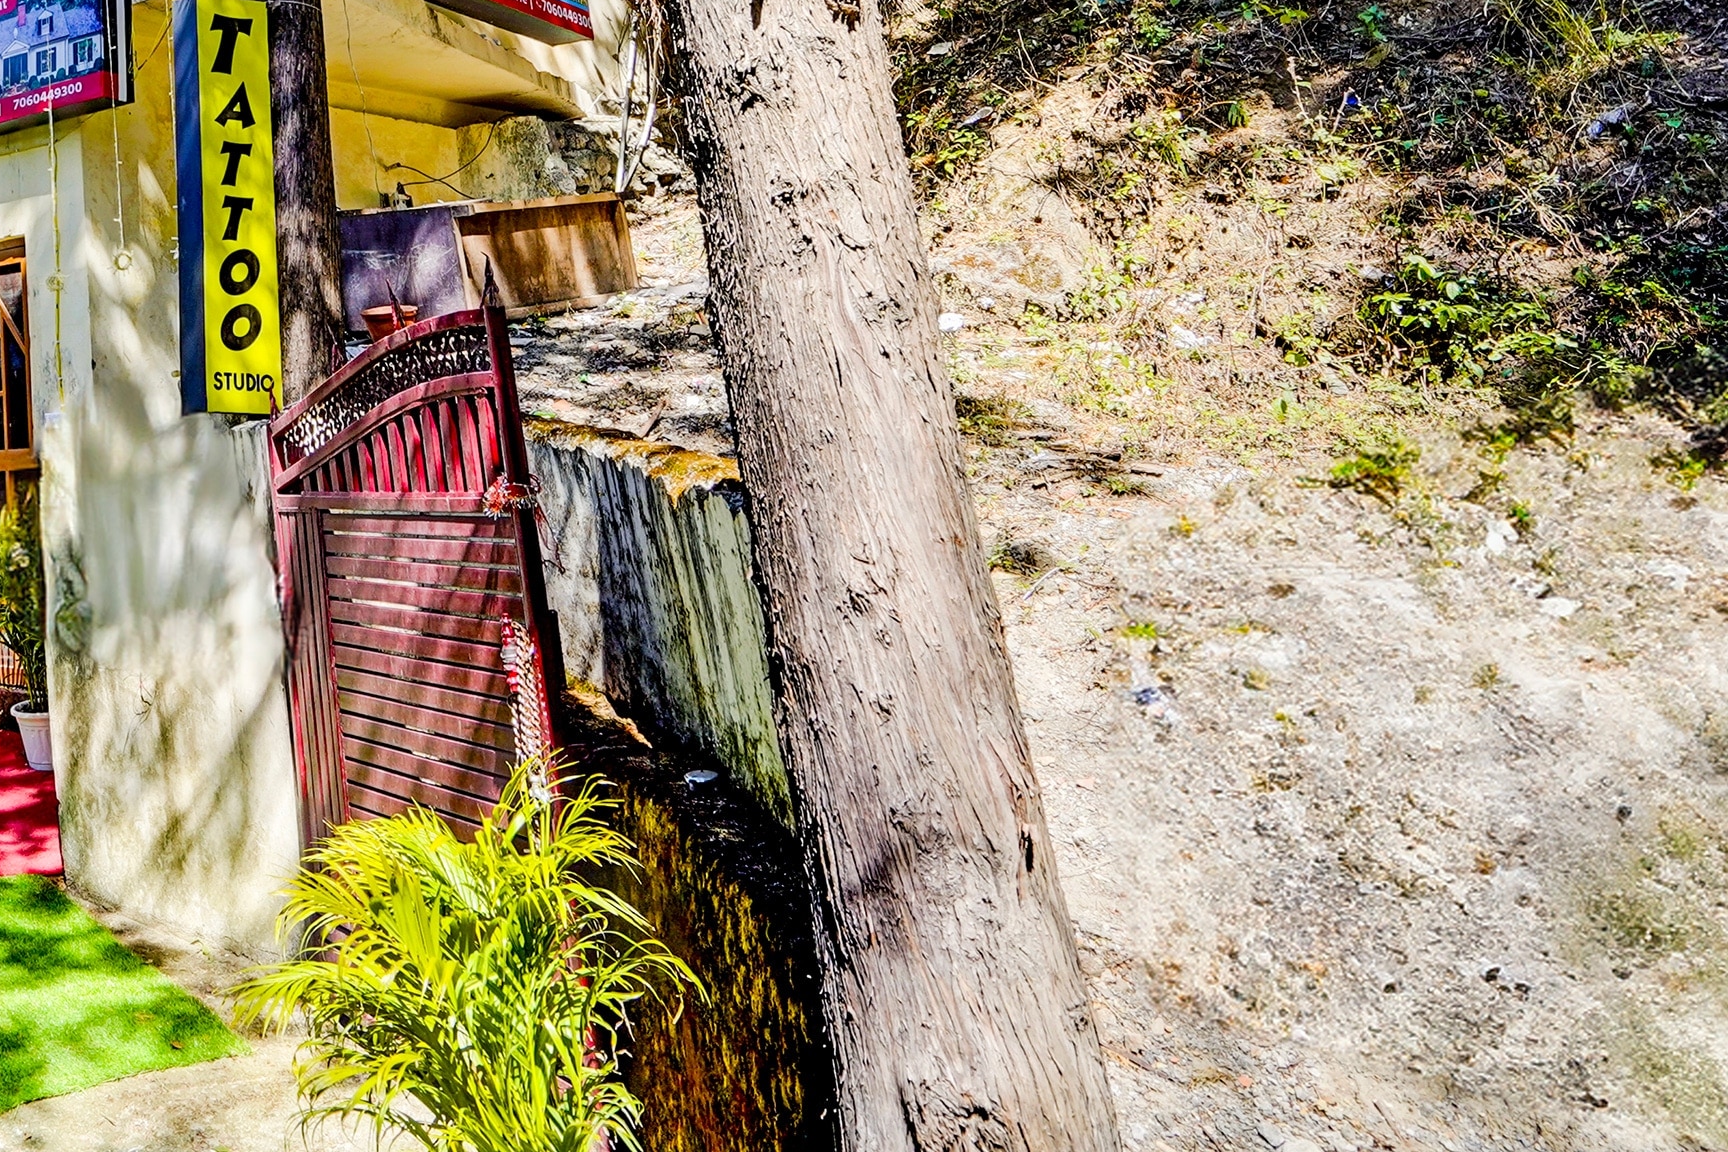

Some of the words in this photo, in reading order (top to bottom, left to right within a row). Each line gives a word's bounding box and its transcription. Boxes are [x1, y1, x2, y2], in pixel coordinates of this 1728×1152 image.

[13, 81, 83, 110] 7060449300
[210, 13, 262, 352] TATTOO
[213, 371, 274, 392] STUDIO
